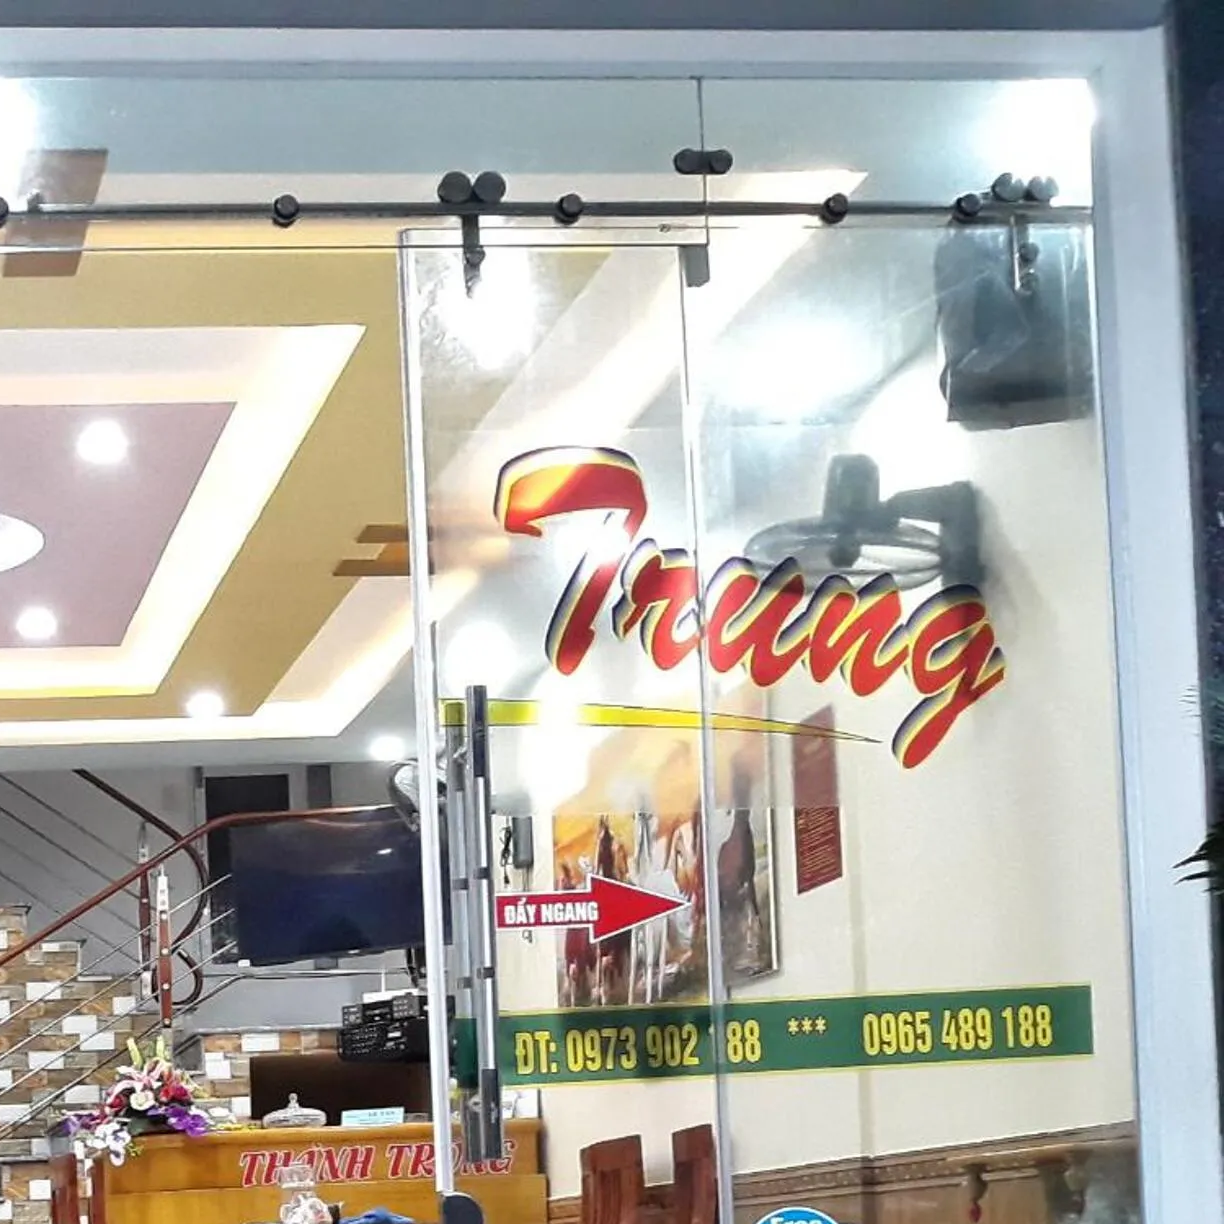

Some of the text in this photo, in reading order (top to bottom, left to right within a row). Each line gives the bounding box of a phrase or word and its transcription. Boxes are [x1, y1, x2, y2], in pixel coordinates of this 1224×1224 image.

[493, 446, 1006, 769] Trung
[541, 901, 599, 924] NGANG
[515, 1004, 1053, 1075] ĐT: 0973 902 88 0965 489 188
